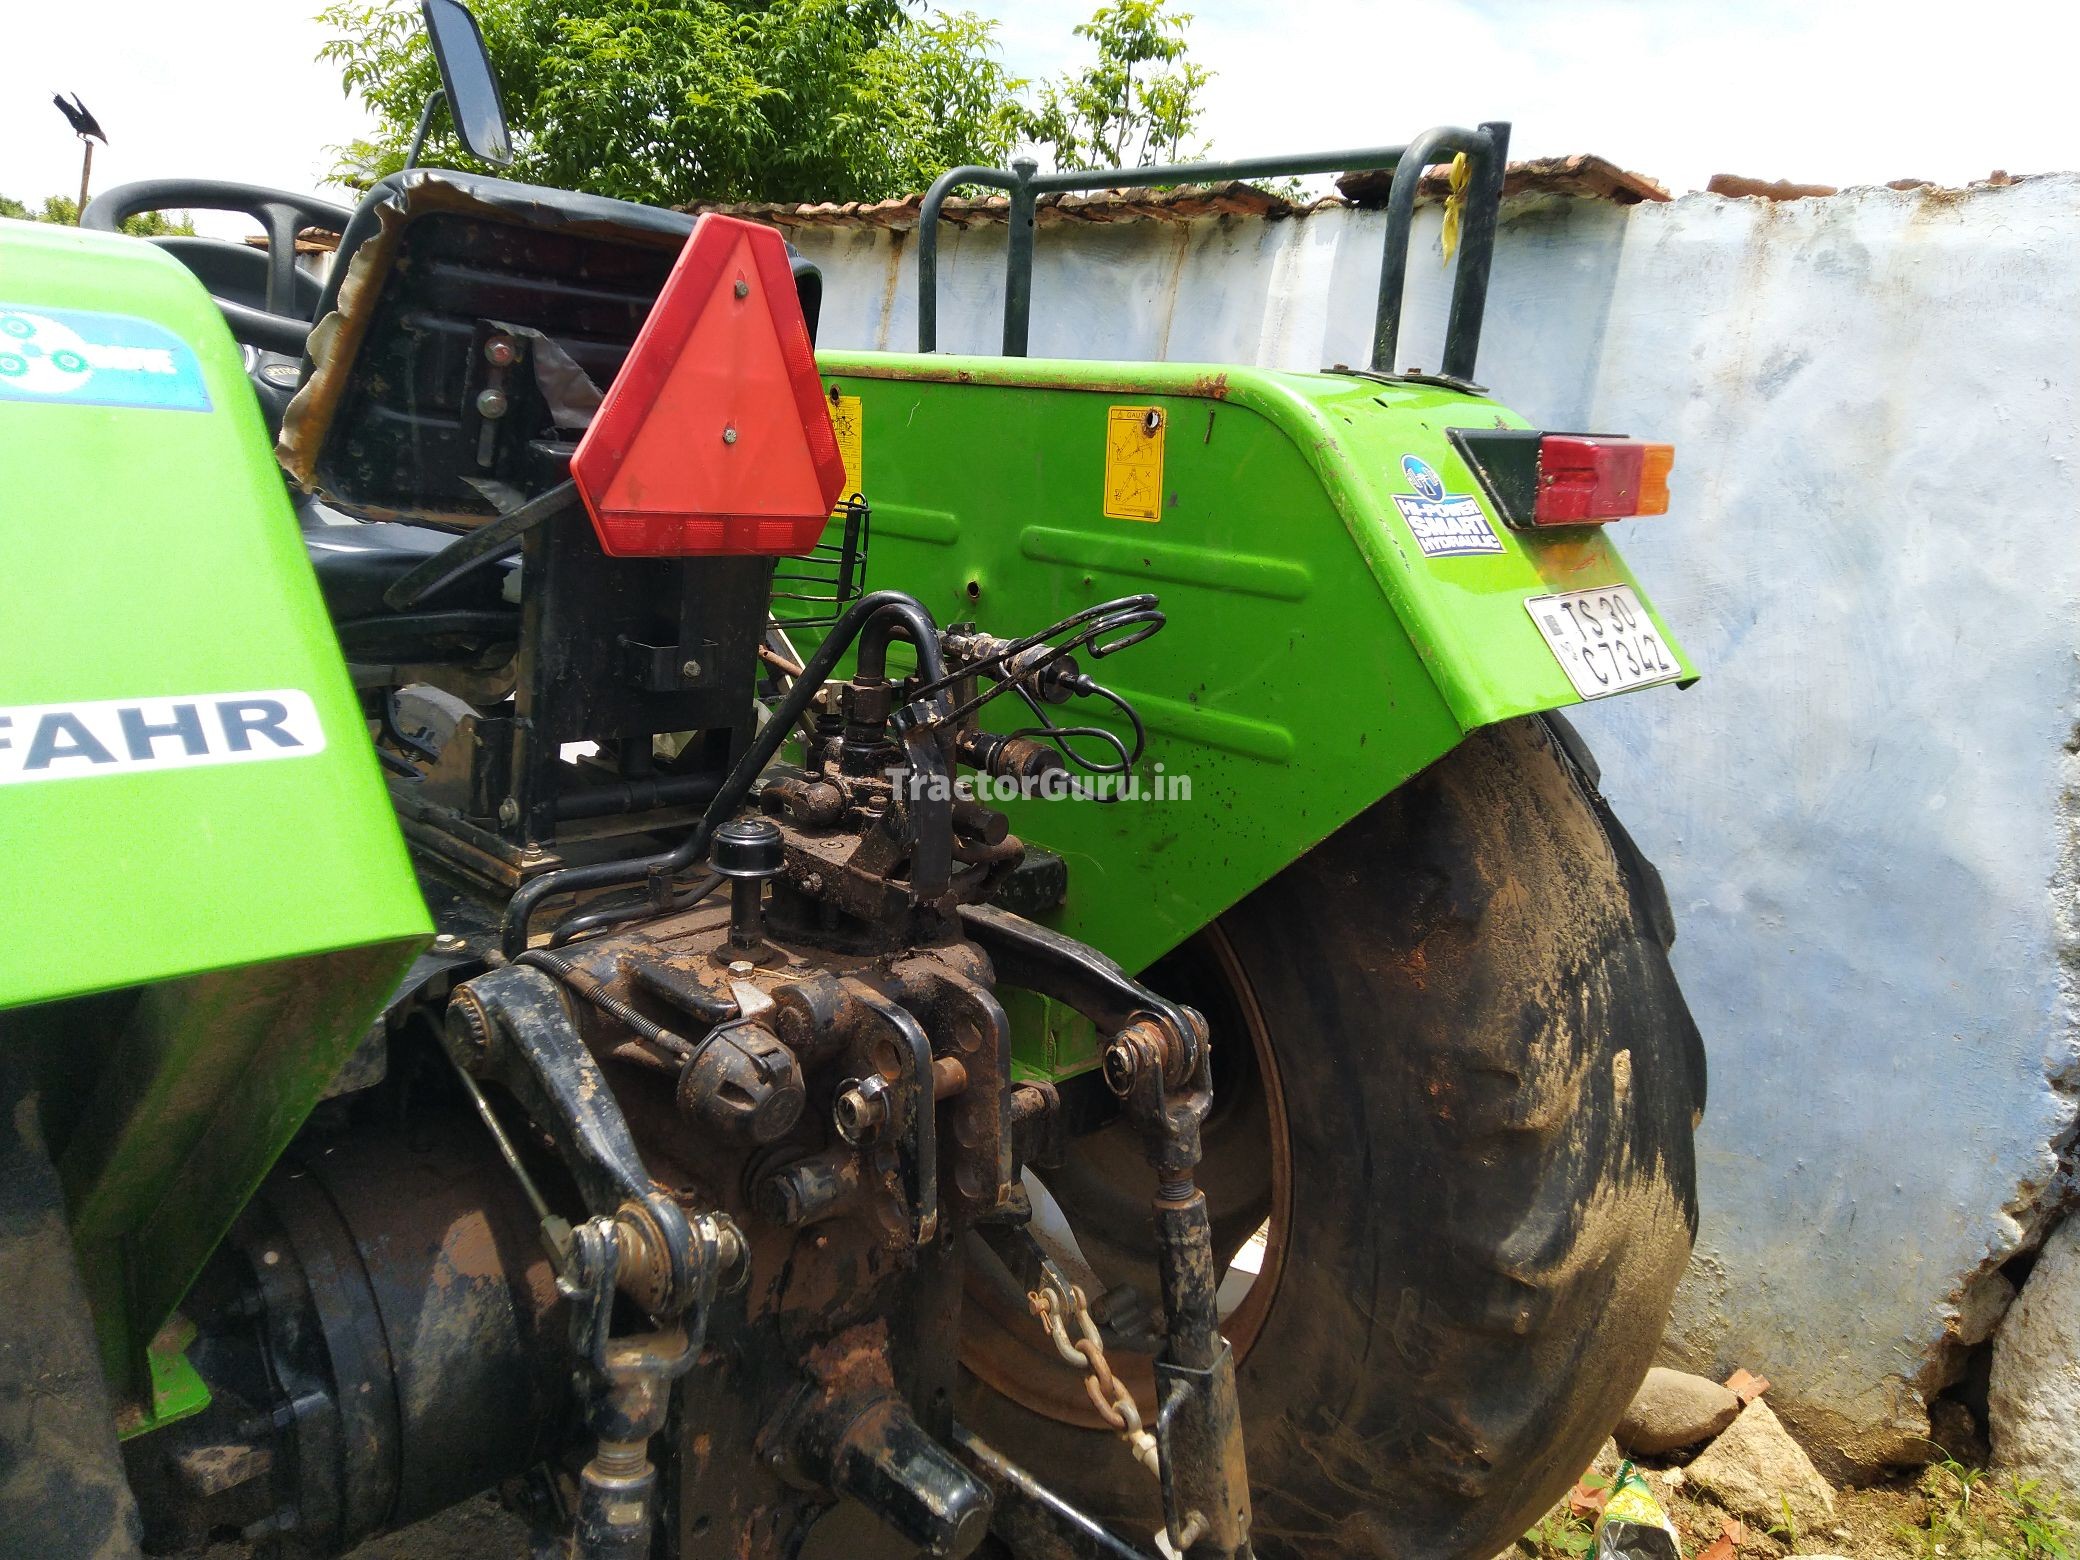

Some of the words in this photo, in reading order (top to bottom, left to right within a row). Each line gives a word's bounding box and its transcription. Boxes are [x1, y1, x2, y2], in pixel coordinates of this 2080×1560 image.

[1407, 514, 1491, 538] SMART
[1418, 534, 1501, 552] HYDRAULIC
[1560, 599, 1604, 643] TS
[0, 699, 304, 770] AHR
